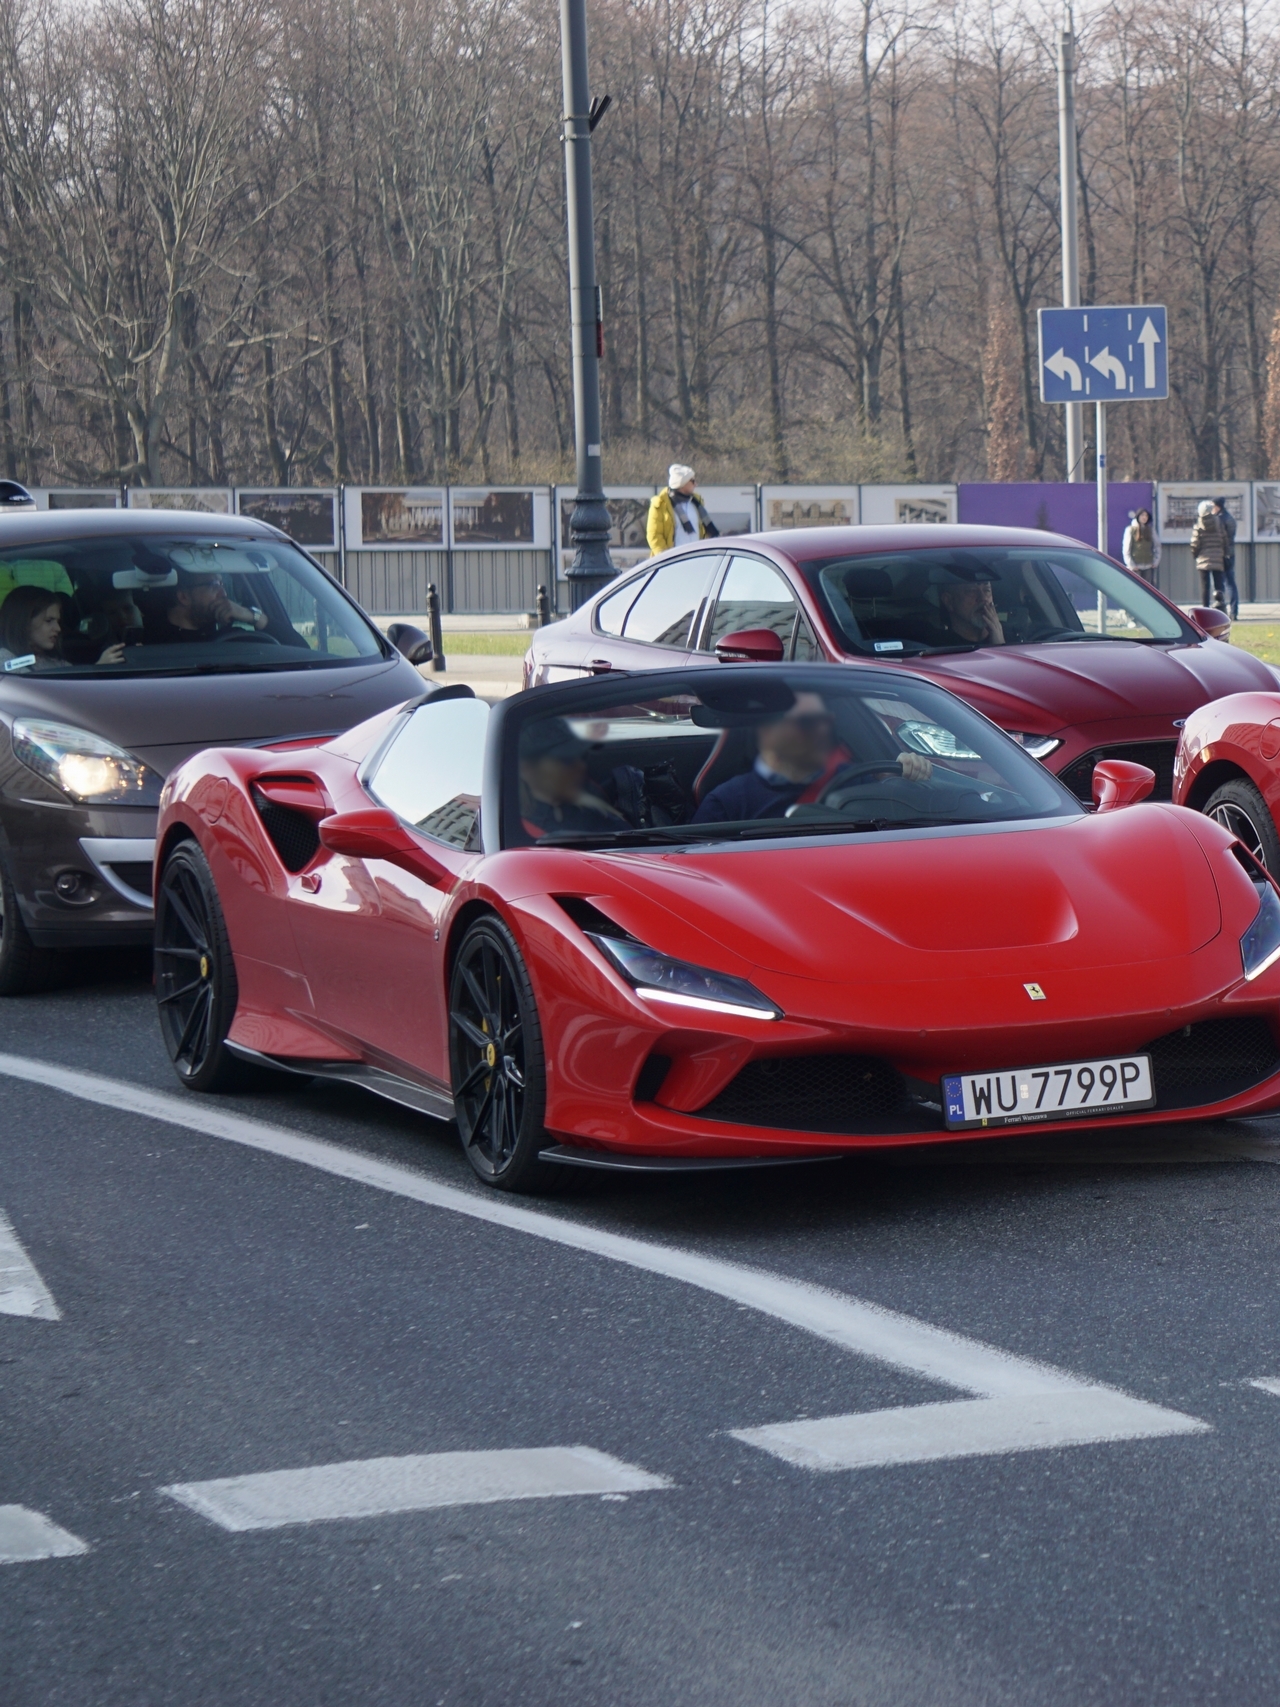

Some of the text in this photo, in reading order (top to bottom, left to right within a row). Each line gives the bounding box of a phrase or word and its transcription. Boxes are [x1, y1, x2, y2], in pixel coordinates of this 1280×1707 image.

[970, 1062, 1140, 1115] WU 7799P
[949, 1104, 963, 1116] PL
[1004, 1113, 1048, 1124] Ferrari Warszawa
